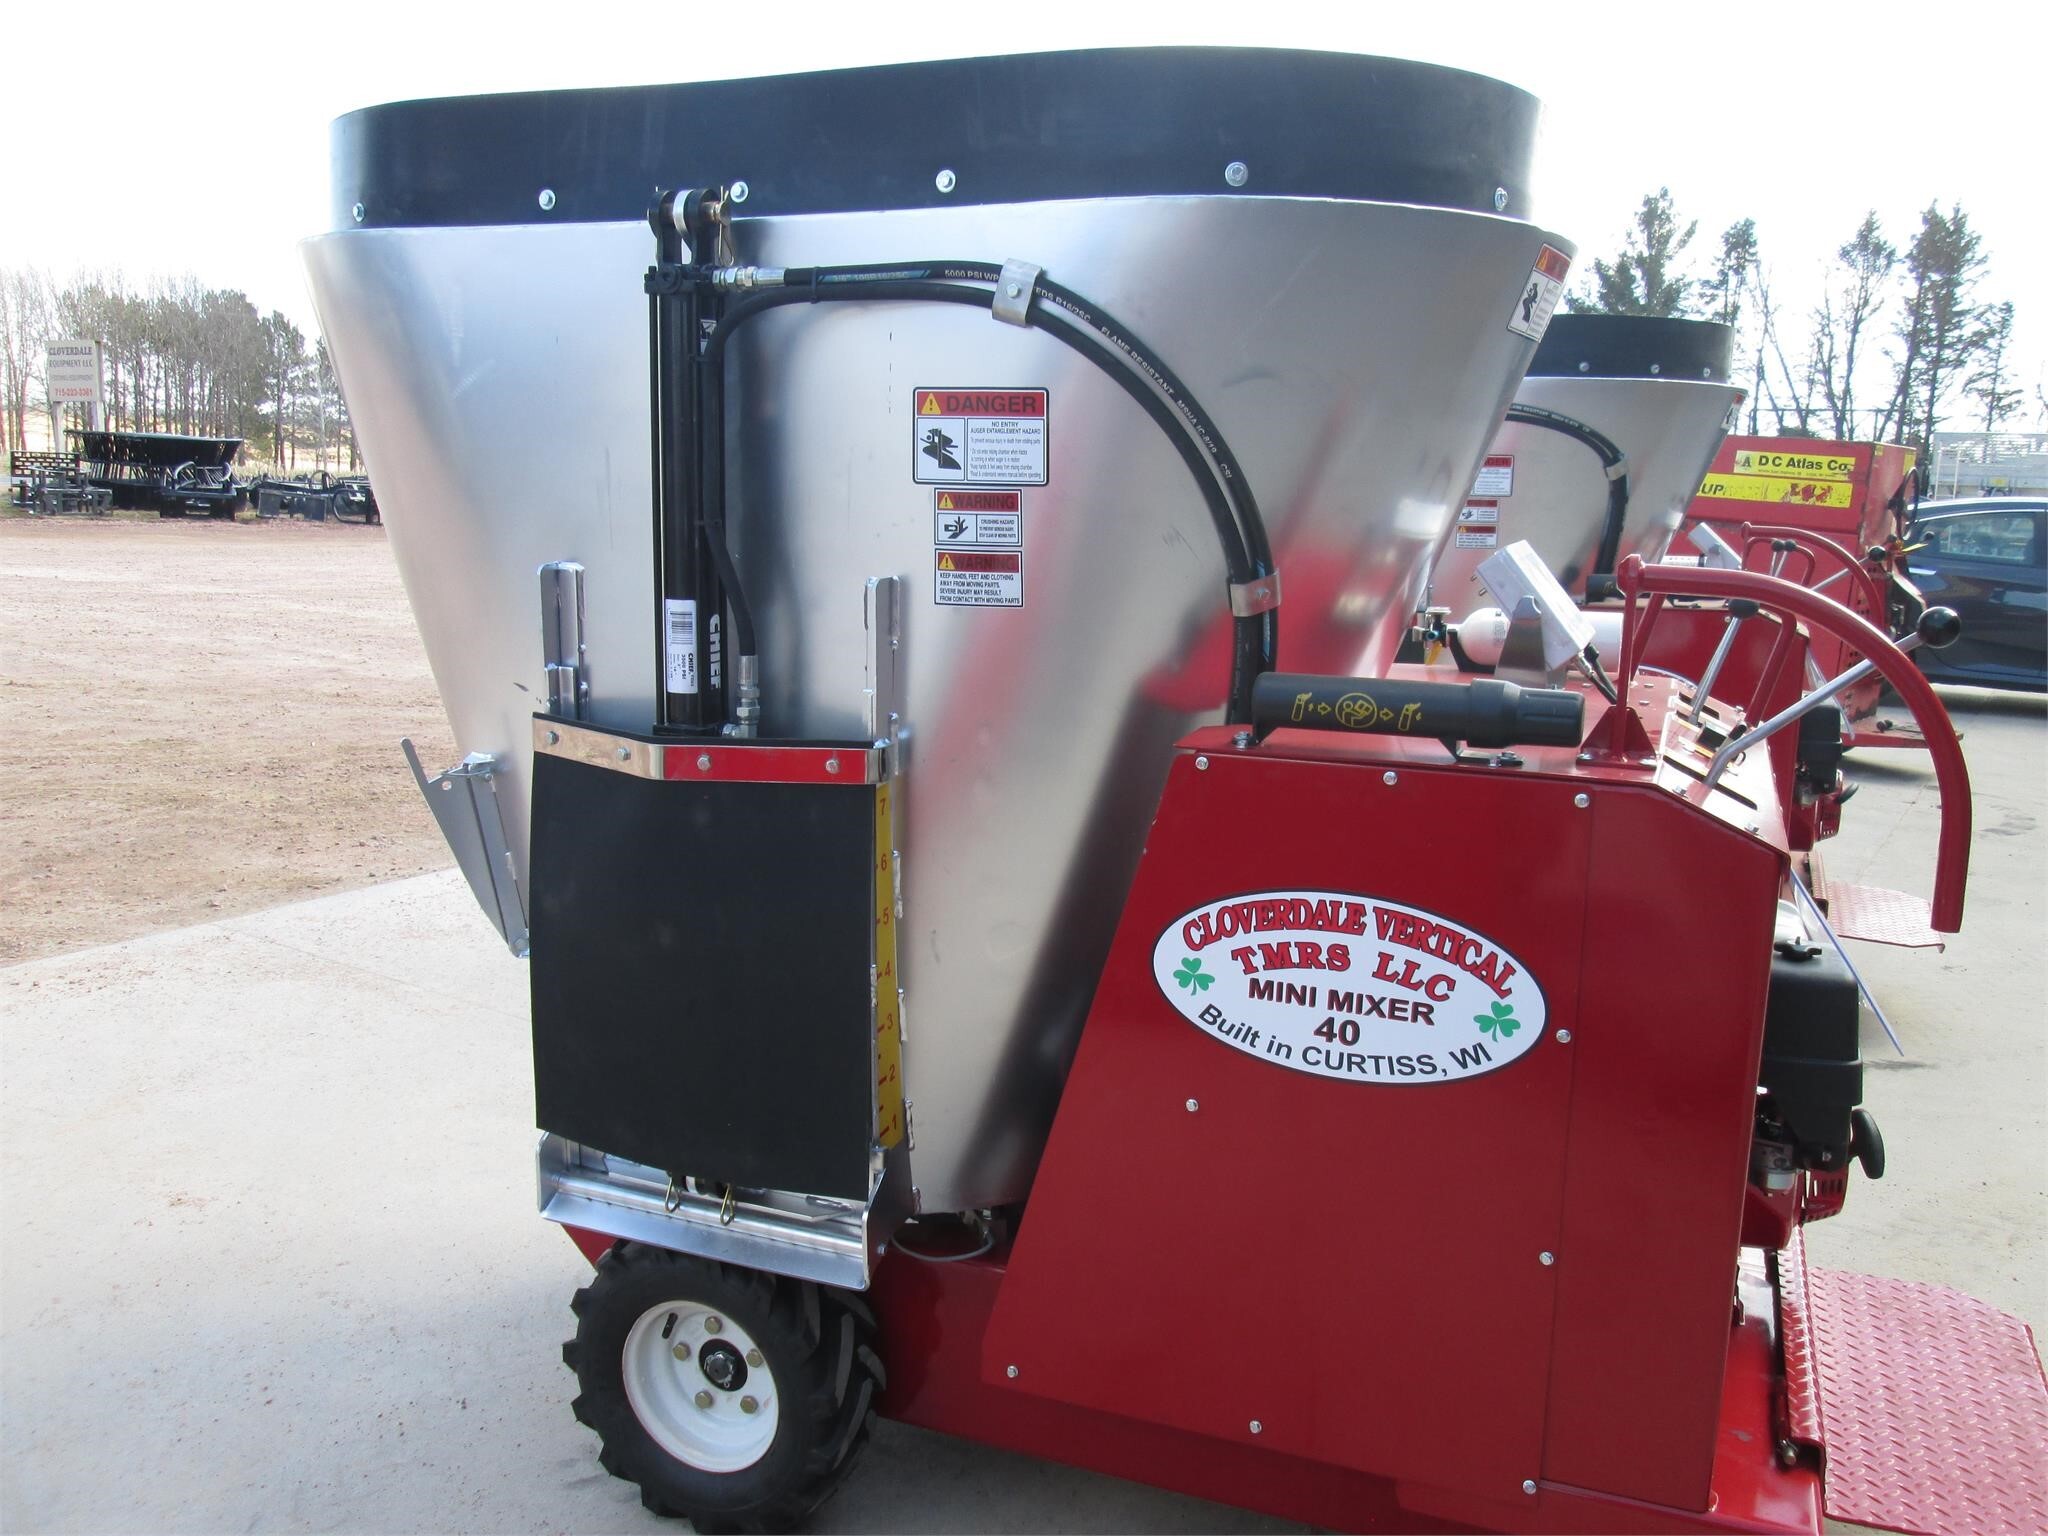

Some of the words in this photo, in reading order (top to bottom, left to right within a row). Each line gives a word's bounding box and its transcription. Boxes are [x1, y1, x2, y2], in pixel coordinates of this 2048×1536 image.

[944, 269, 966, 279] 5000
[968, 270, 983, 280] PSI
[1100, 326, 1130, 352] FLAME
[48, 346, 93, 356] CLOVERDALE
[945, 395, 1037, 413] DANGER
[1786, 457, 1823, 470] Atlas
[954, 494, 1015, 509] WARNING
[710, 614, 721, 688] CHIEF
[880, 798, 887, 816] 7
[880, 853, 888, 871] 6
[882, 906, 890, 925] 5
[1182, 898, 1369, 952] CLOVERDALE
[1372, 906, 1518, 1000] VERTICAL
[884, 960, 892, 977] 4
[1231, 941, 1352, 976] TMRS
[1372, 952, 1456, 1002] LLC
[1248, 976, 1318, 1008] MINI
[1327, 988, 1436, 1026] MIXER
[887, 1012, 894, 1030] 3
[1198, 1003, 1260, 1048] Built
[1266, 1034, 1294, 1060] in
[1301, 1045, 1449, 1078] CURTISS,
[1448, 1042, 1493, 1070] WI
[1313, 1016, 1361, 1047] 40
[888, 1064, 896, 1082] 2
[891, 1113, 897, 1131] 1
